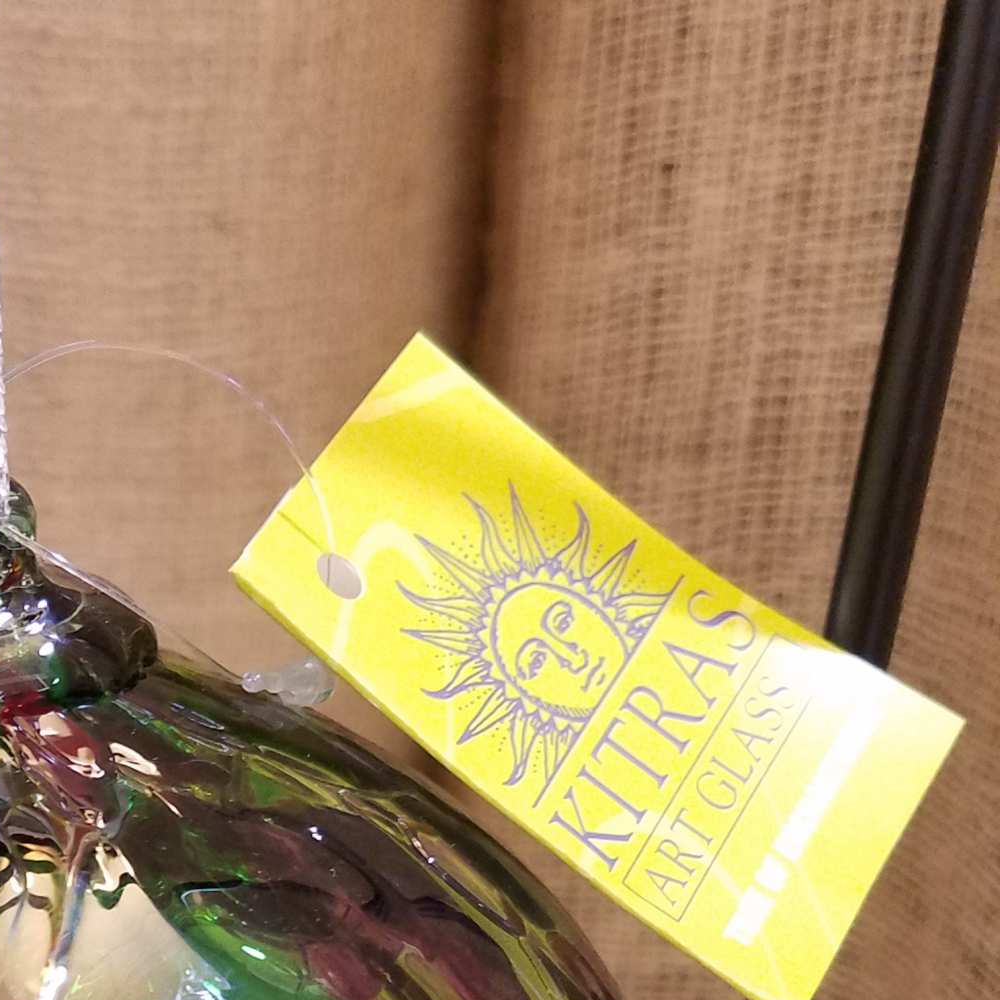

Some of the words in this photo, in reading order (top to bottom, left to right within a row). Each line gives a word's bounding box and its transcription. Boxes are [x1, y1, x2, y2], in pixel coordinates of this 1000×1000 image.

[549, 589, 756, 872] KITRAS
[645, 808, 713, 906] ART
[696, 676, 793, 810] GLASS
